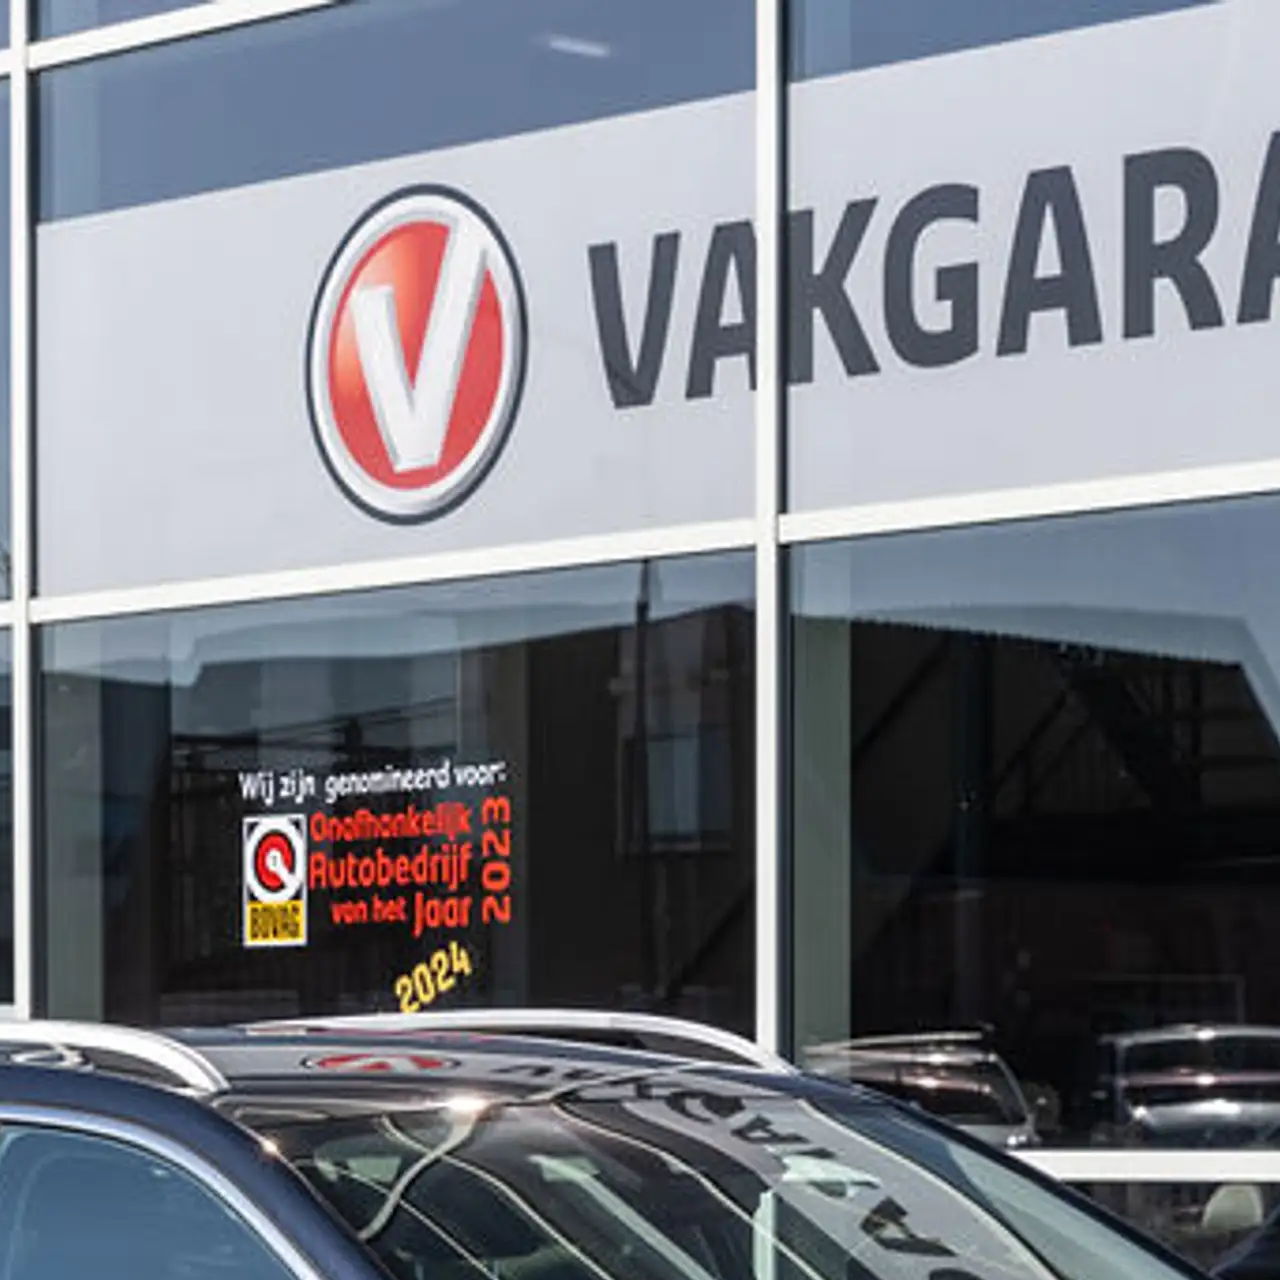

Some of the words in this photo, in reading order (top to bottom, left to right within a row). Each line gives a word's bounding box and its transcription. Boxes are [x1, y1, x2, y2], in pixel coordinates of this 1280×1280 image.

[238, 770, 274, 806] Wij
[279, 769, 315, 804] zijn
[324, 758, 450, 803] genomineerd
[309, 840, 472, 892] Autobedrijf
[481, 795, 511, 924] 2023
[331, 901, 368, 924] van
[371, 895, 407, 923] het
[395, 941, 471, 1013] 2024
